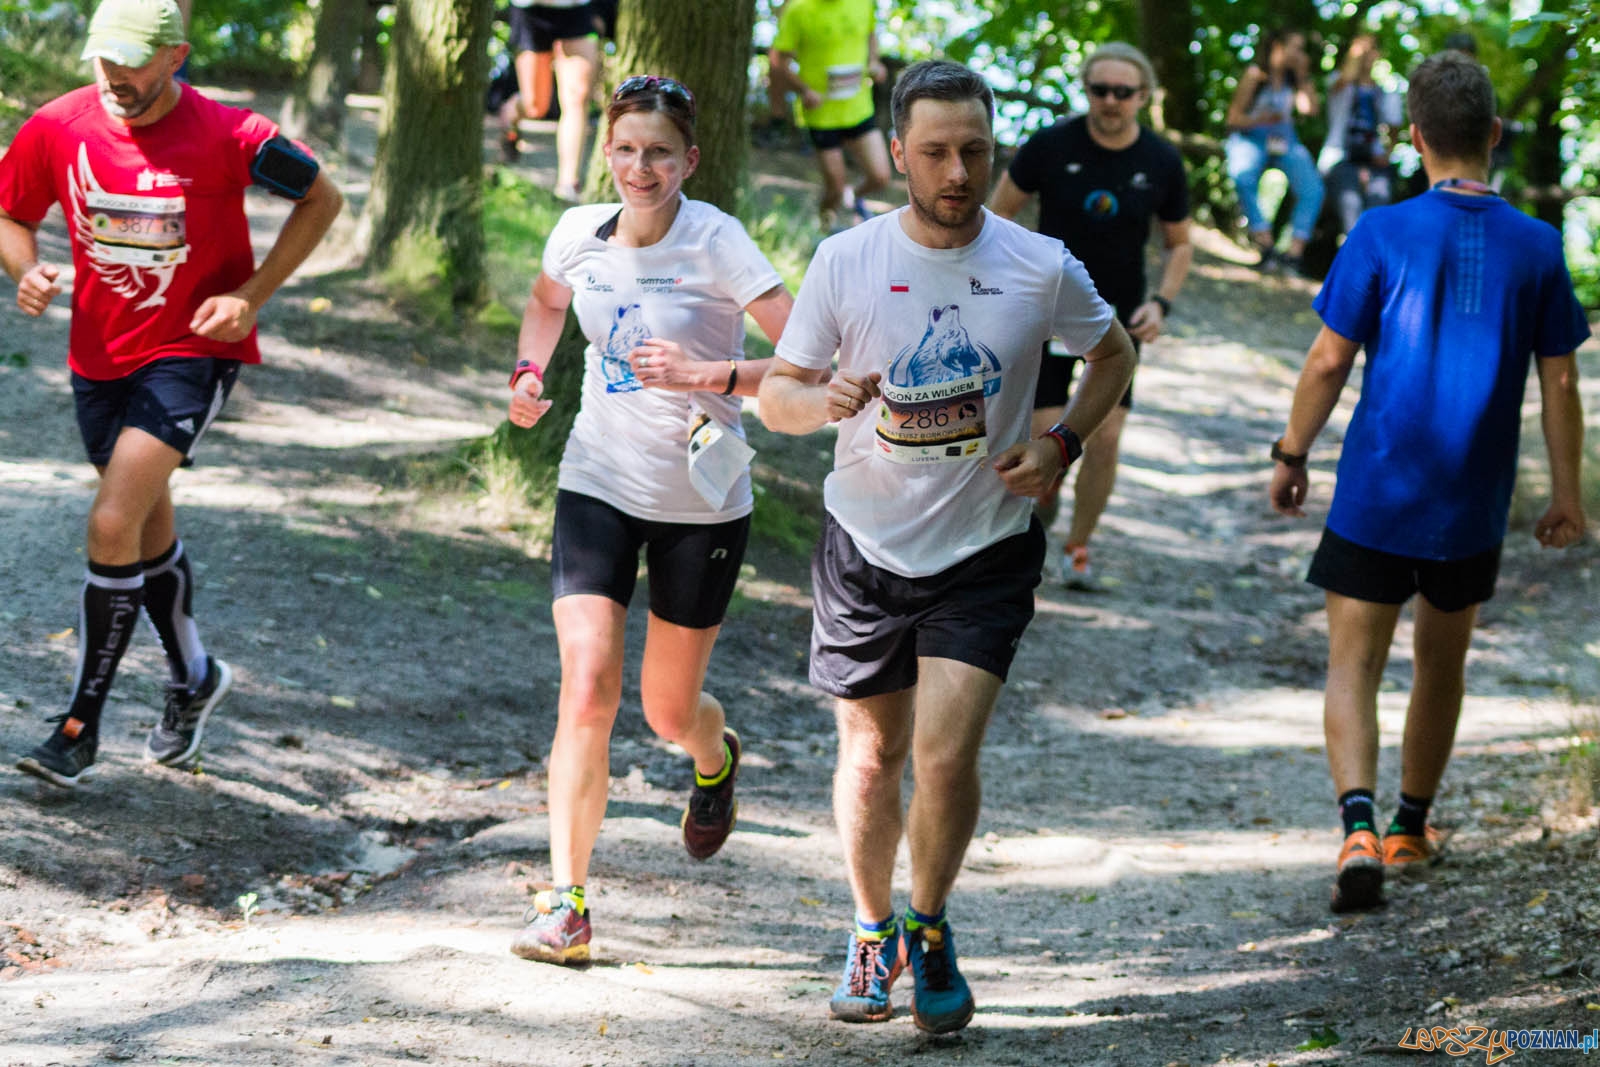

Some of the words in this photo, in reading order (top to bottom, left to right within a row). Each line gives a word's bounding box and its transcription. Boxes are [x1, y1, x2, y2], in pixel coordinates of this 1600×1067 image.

[118, 217, 153, 234] 387
[915, 392, 929, 401] ZA
[931, 381, 975, 398] WILKIEM
[900, 406, 950, 429] 286
